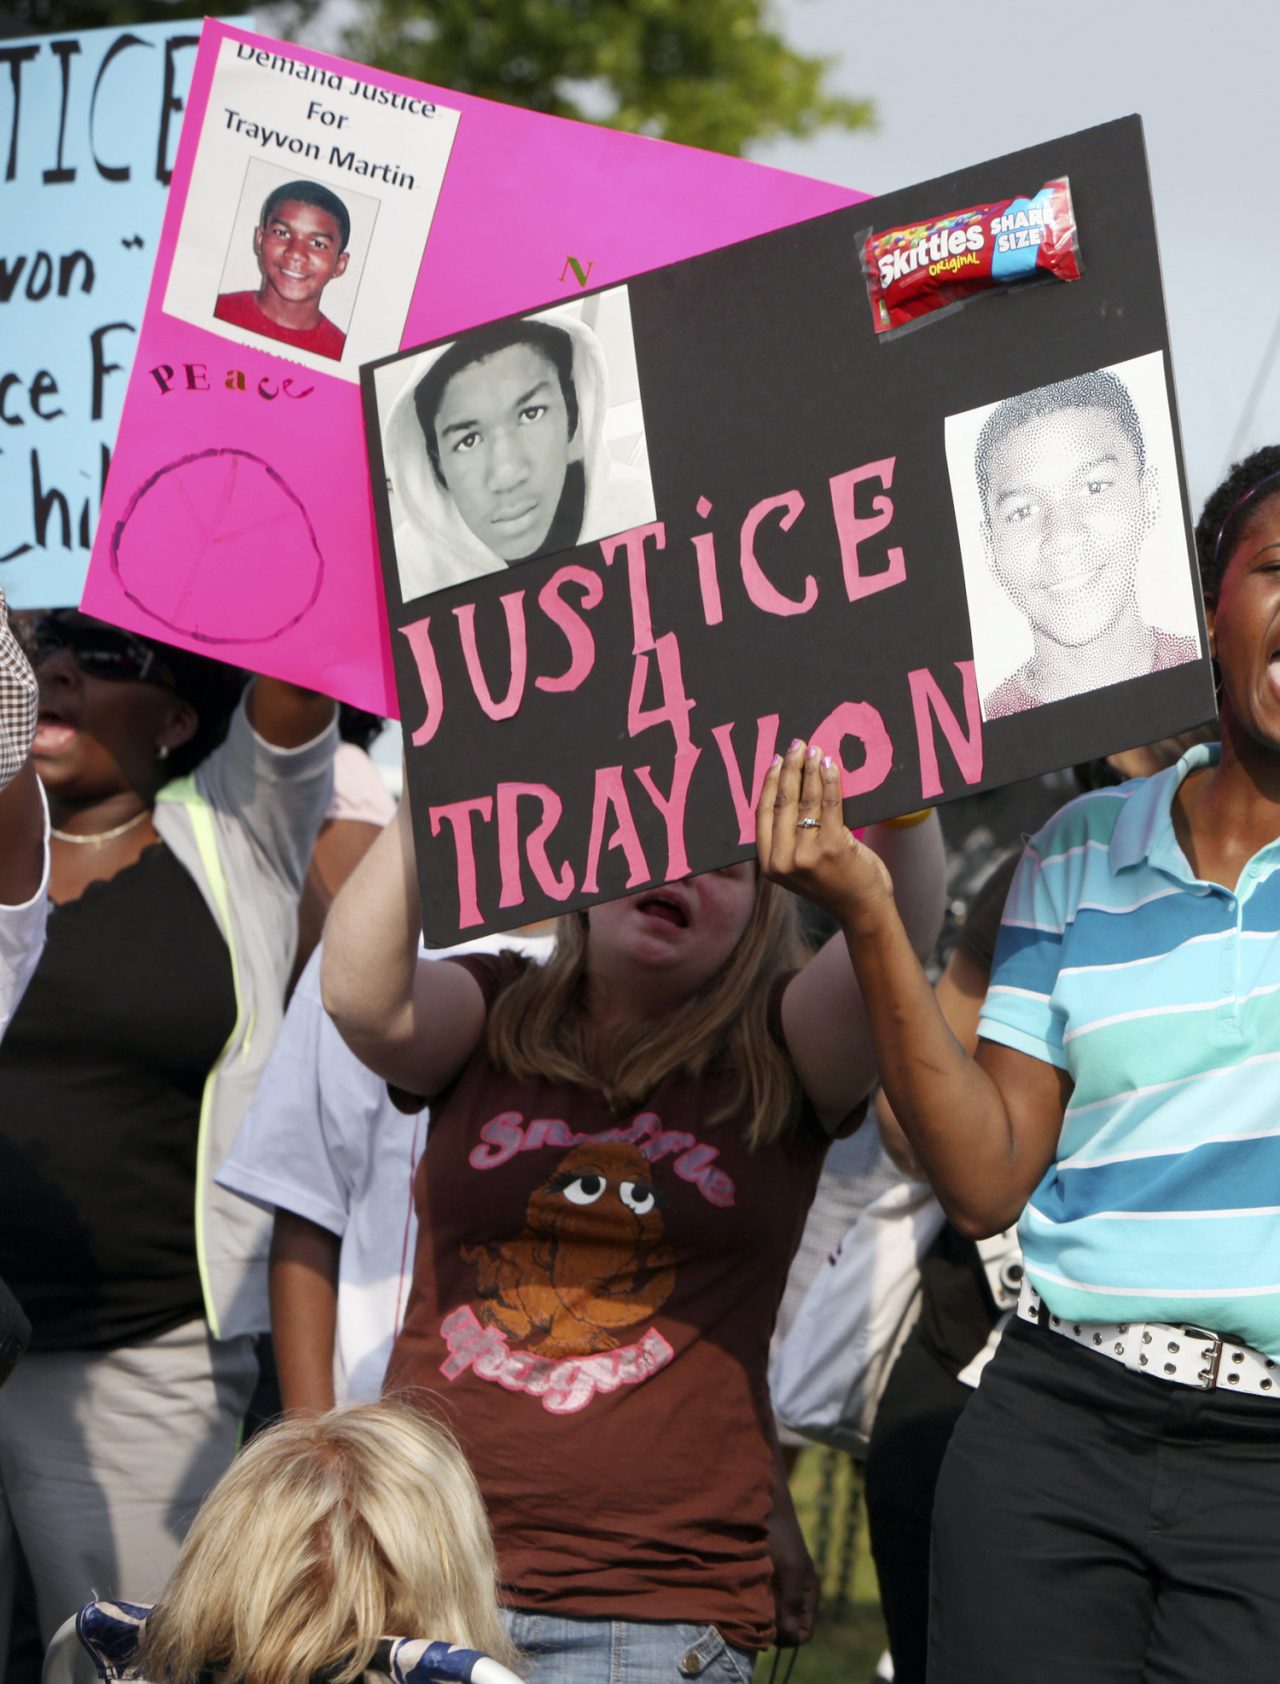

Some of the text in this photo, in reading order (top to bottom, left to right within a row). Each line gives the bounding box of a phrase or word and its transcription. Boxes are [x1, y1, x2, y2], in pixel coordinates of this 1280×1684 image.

[236, 43, 436, 119] Demand Justice
[306, 101, 349, 130] For
[224, 107, 416, 190] Trayvon Martin
[558, 256, 594, 287] N
[877, 224, 985, 290] Skittles
[997, 227, 1042, 254] SIZE
[626, 631, 697, 758] 4
[428, 660, 984, 931] TRAYVON
